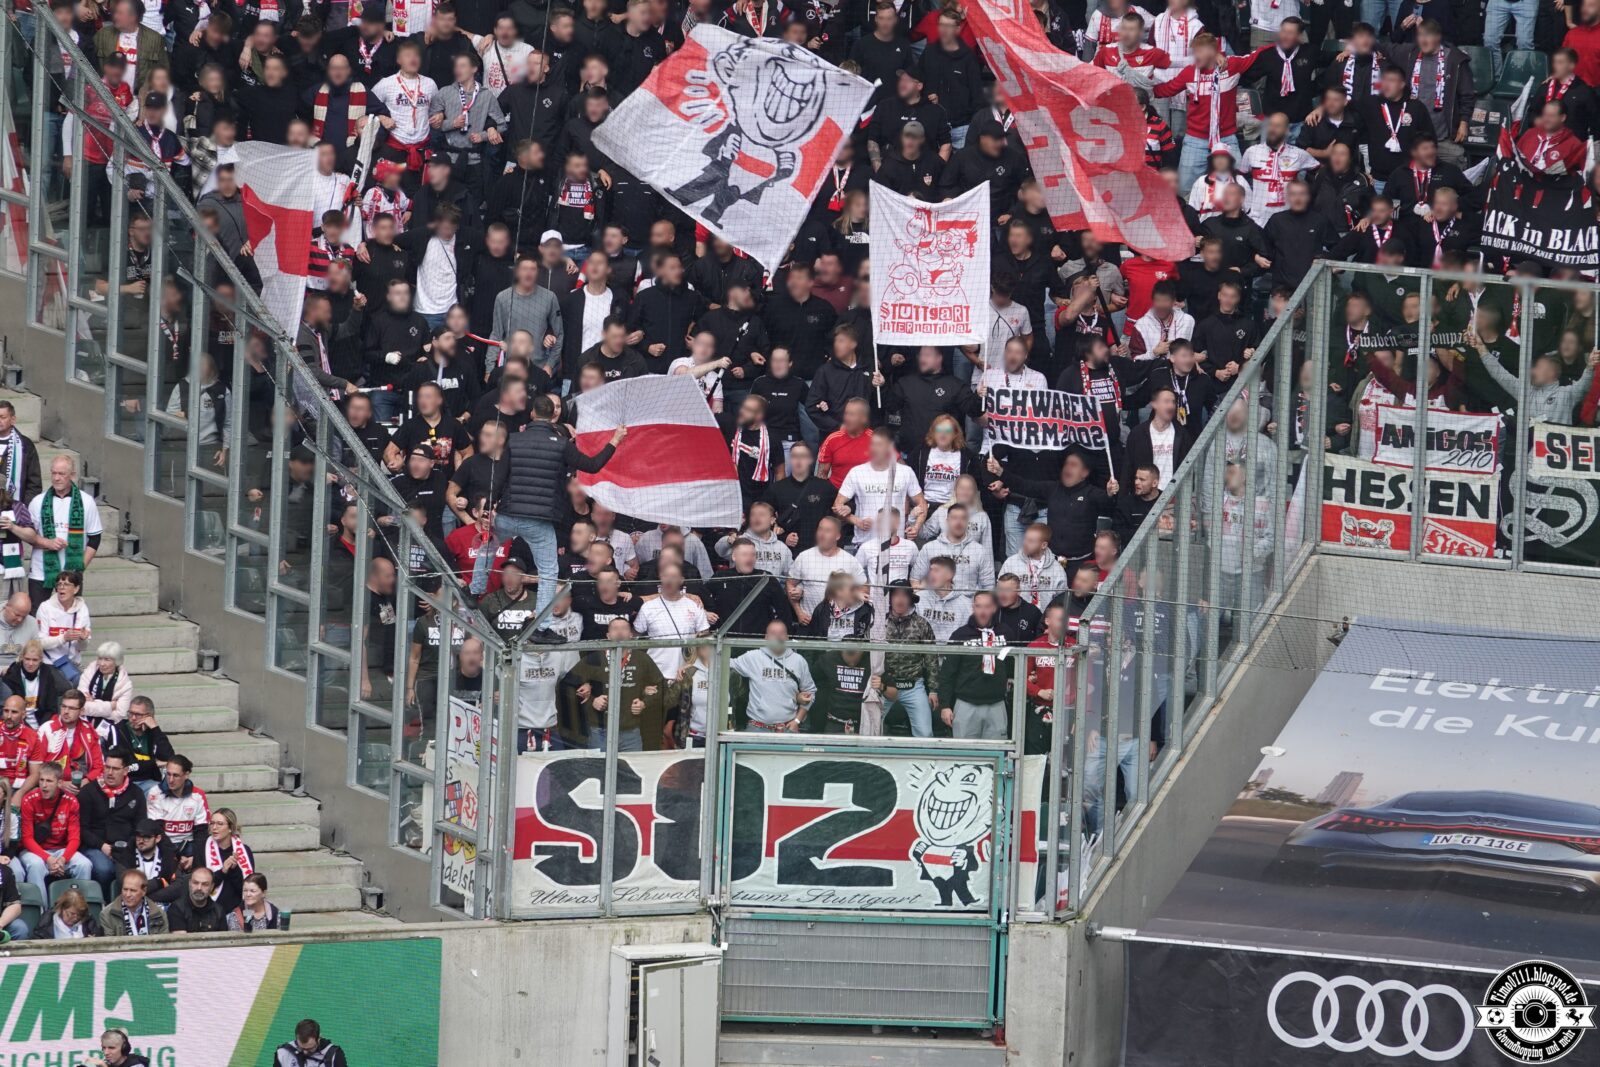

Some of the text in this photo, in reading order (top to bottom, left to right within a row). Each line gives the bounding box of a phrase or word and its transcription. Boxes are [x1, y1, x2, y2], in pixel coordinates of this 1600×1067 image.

[1482, 209, 1519, 237] ACK
[1521, 221, 1543, 247] in
[1510, 240, 1553, 260] KOMPANIE
[986, 387, 1101, 423] SCHWABEN
[987, 417, 1106, 448] STURM 2002
[1441, 450, 1494, 469] 2010
[1369, 705, 1474, 734] die
[164, 821, 194, 833] EnBW
[1433, 835, 1528, 852] IN GT 116E
[531, 888, 599, 904] Ultras
[796, 888, 923, 908] Stuttgart
